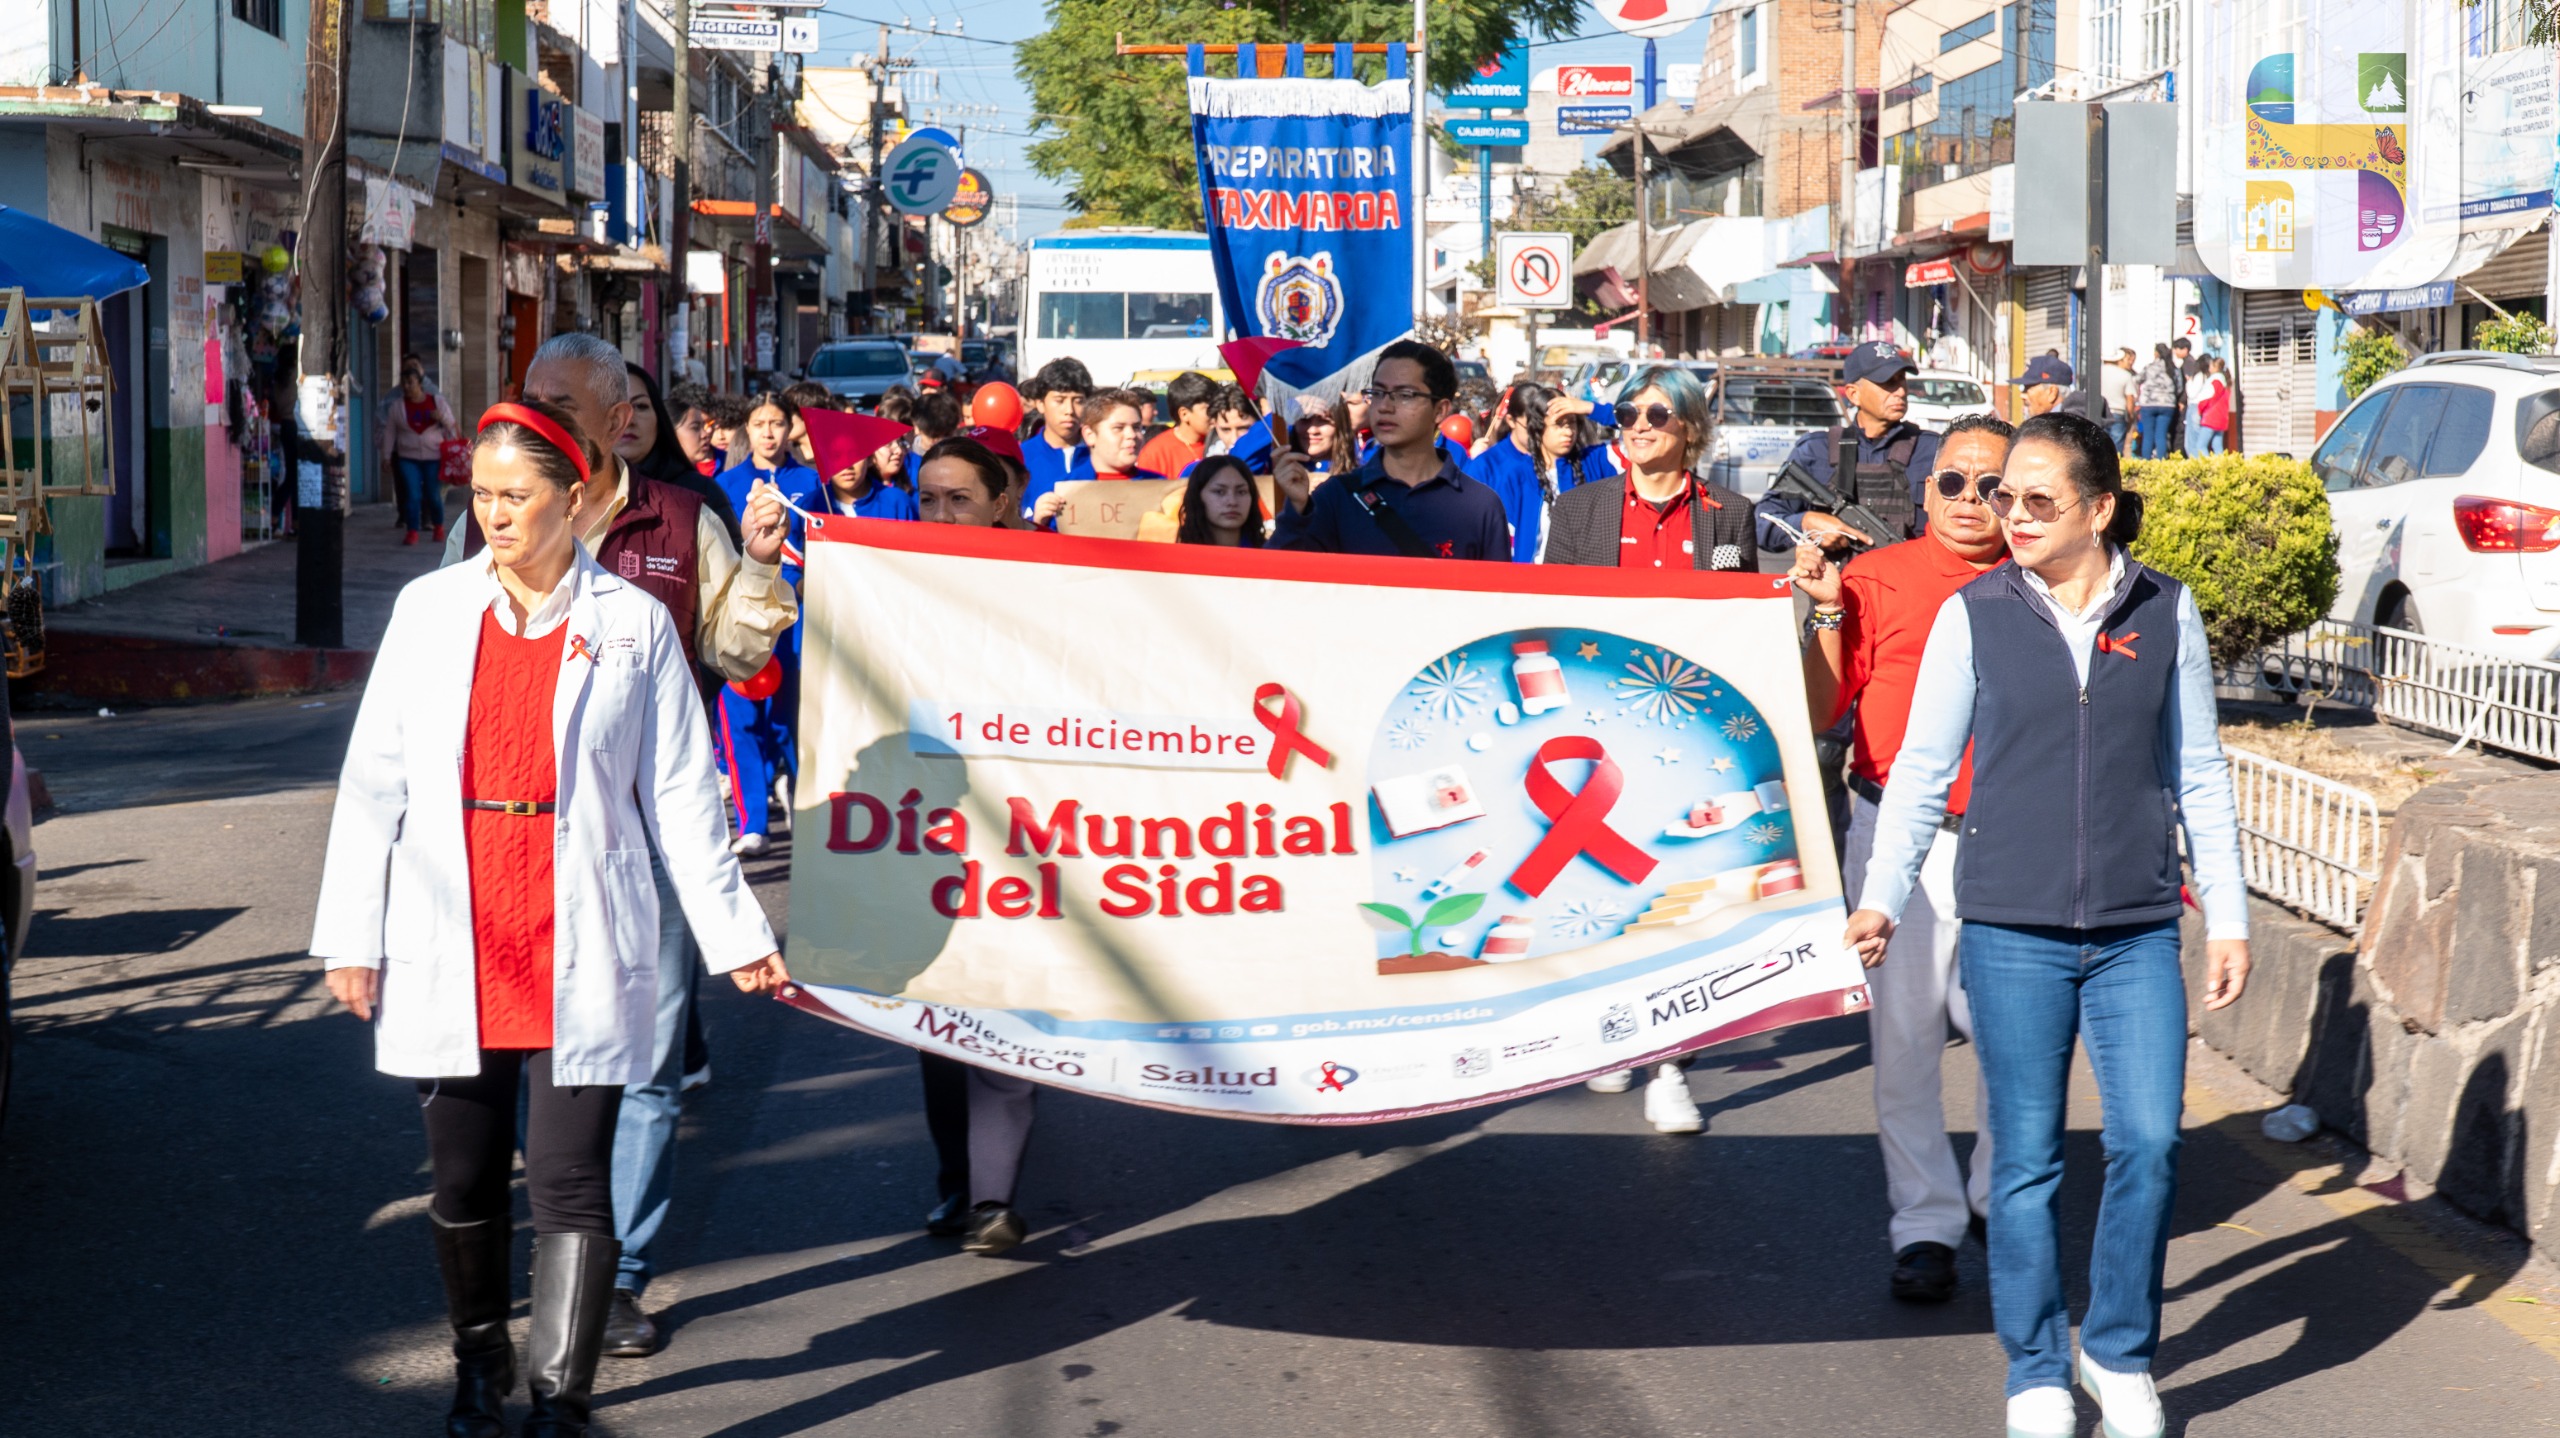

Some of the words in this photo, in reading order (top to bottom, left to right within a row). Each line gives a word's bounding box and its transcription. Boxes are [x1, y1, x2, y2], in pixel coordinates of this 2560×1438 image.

[1202, 145, 1397, 179] PREPARATORIA
[1208, 187, 1401, 232] TAXIMAROA
[2185, 316, 2197, 335] 2
[1101, 503, 1126, 524] DE
[656, 563, 675, 573] Salud
[947, 712, 965, 742] 1
[981, 713, 1030, 745] de
[1046, 717, 1257, 756] diciembre
[825, 788, 970, 857] Día
[1005, 797, 1358, 860] Mundial
[930, 859, 1063, 920] del
[1099, 861, 1285, 919] Sida
[912, 1004, 1086, 1078] México
[934, 1004, 1046, 1056] obierno
[1290, 1006, 1495, 1038] gob.mx/censida
[1139, 1063, 1279, 1088] Salud
